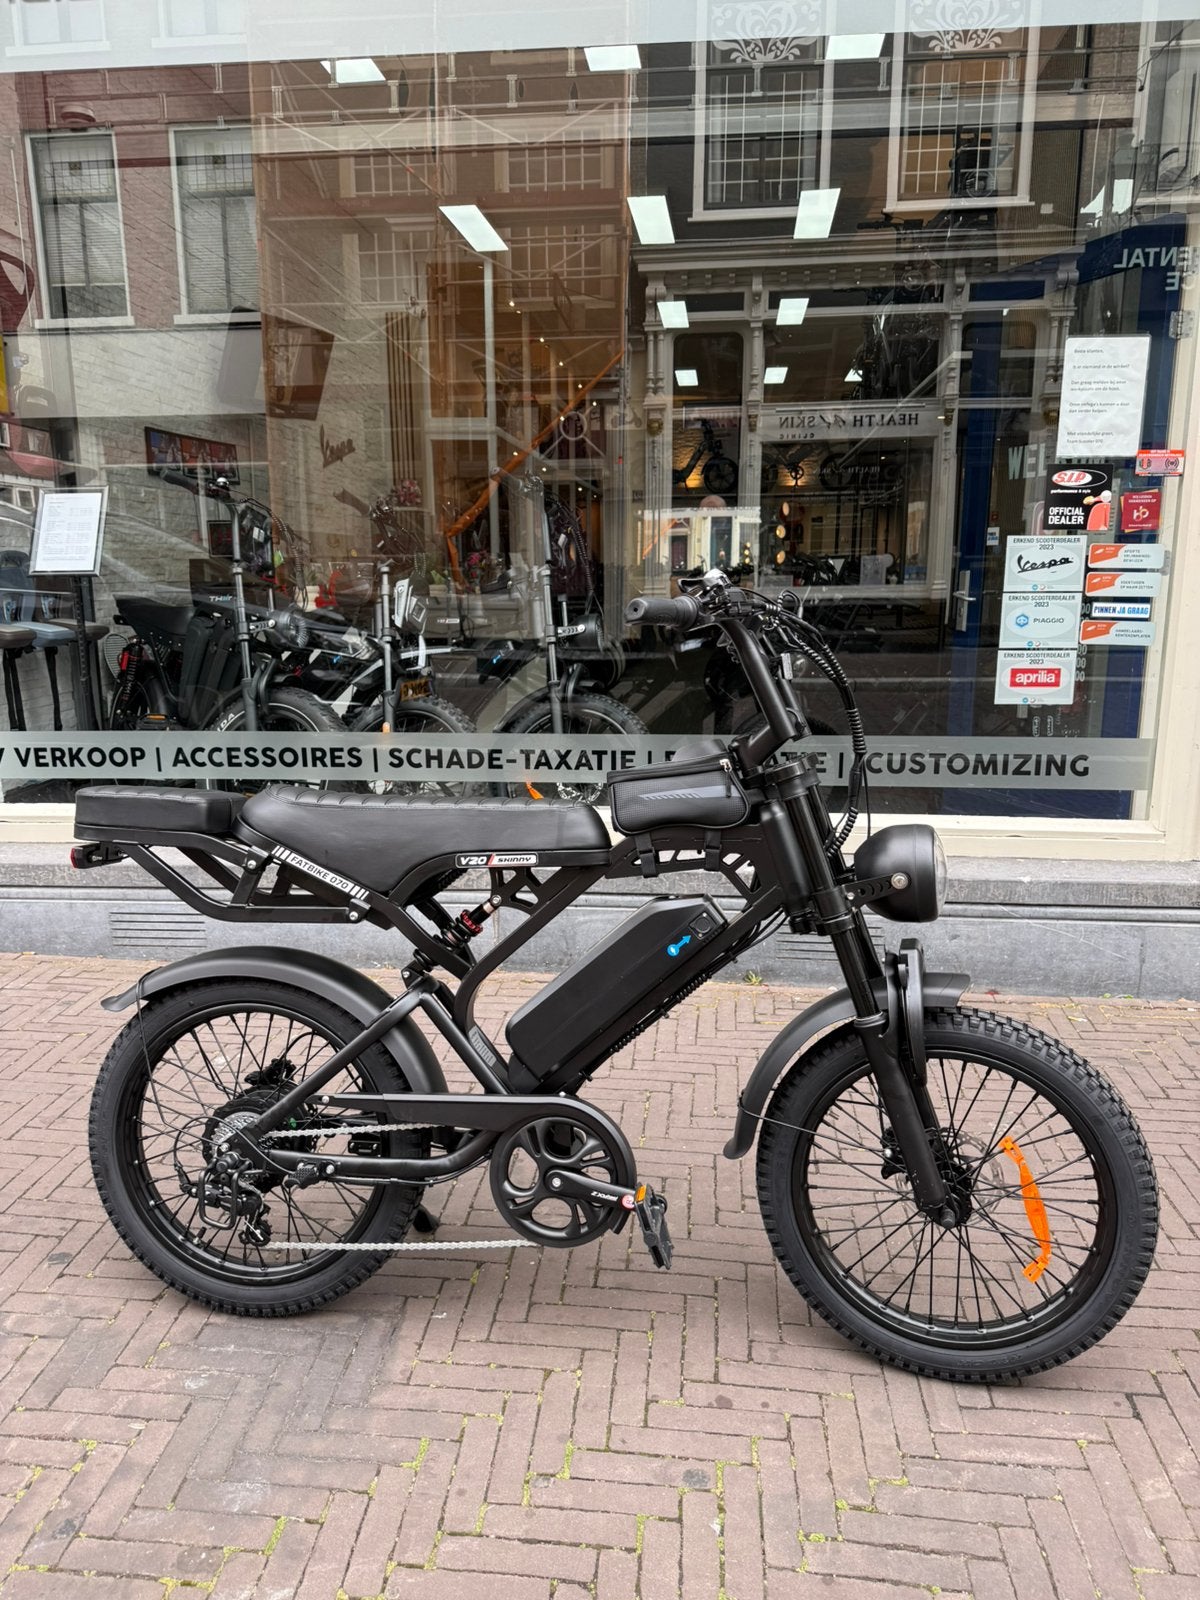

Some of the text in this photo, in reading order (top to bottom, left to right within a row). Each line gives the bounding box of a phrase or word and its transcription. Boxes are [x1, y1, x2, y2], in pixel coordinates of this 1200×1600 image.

[1048, 506, 1085, 516] OFFICIAL
[1048, 516, 1084, 525] DEALER
[1017, 554, 1074, 574] Vespa
[1094, 606, 1149, 615] PINNEN JA GRAAG
[1015, 670, 1056, 685] aprilia
[13, 746, 146, 768] VERKOOP
[172, 746, 363, 768] ACCESSOIRES
[388, 748, 636, 771] SCHADE-TAXATIE
[866, 752, 1090, 777] CUSTOMIZING
[460, 856, 488, 866] V20
[290, 856, 349, 890] FATBIKE 070
